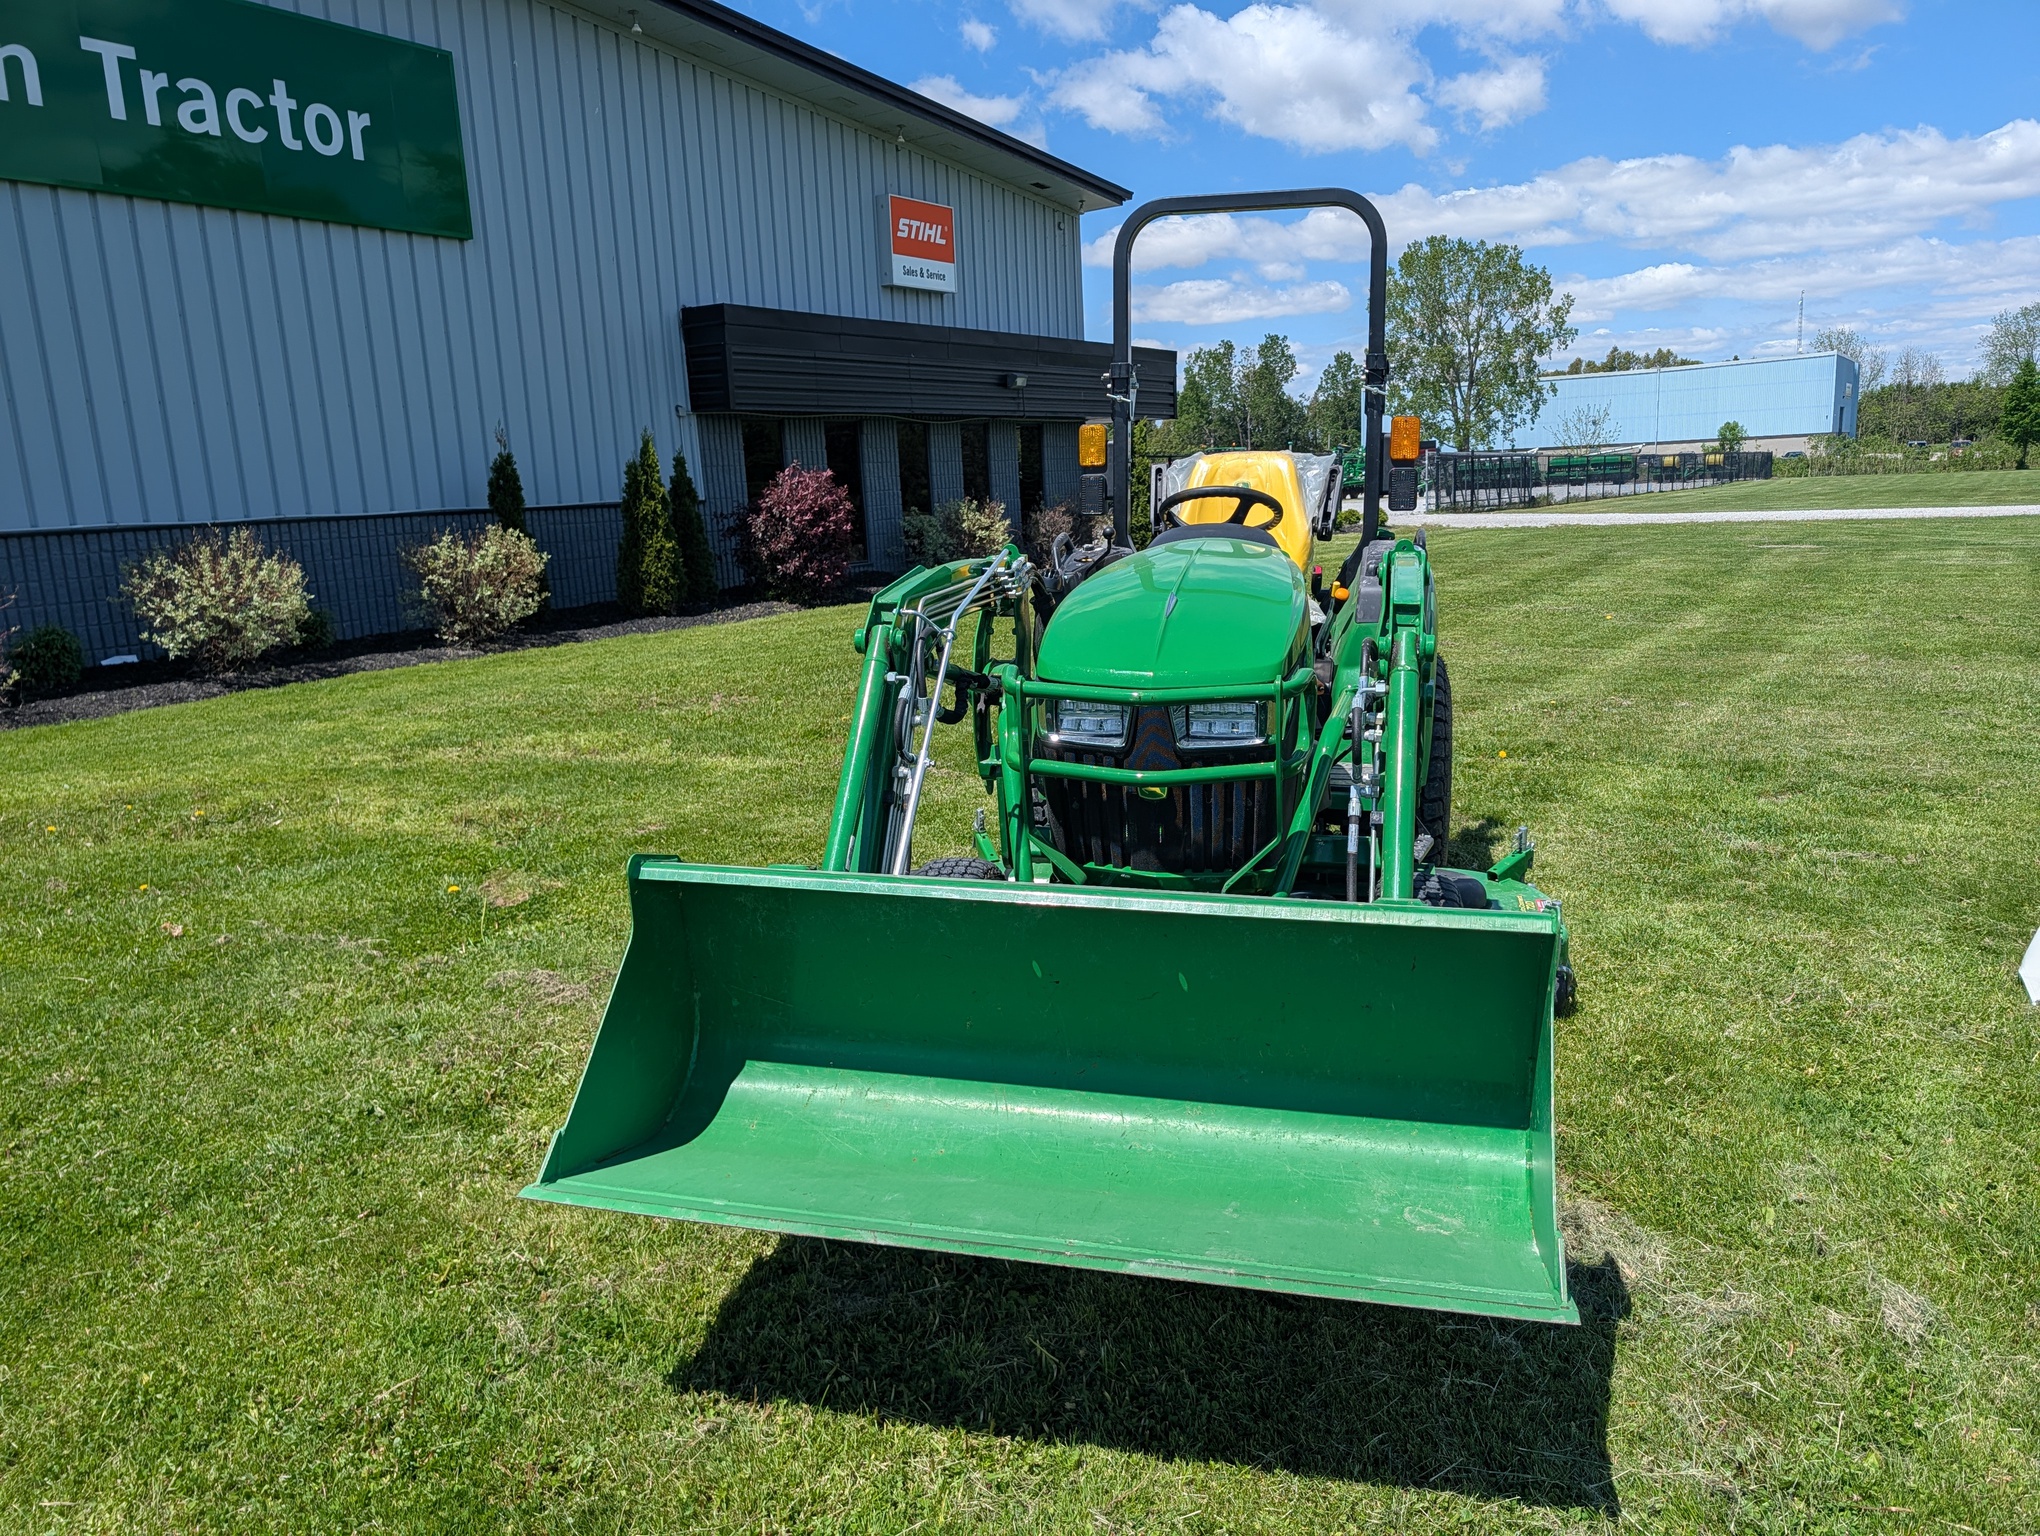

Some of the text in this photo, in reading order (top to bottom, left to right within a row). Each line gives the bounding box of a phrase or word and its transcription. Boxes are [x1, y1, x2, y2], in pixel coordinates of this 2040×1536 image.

[79, 35, 371, 161] Tractor
[897, 217, 946, 245] STIHL
[902, 265, 946, 281] Sales & Service
